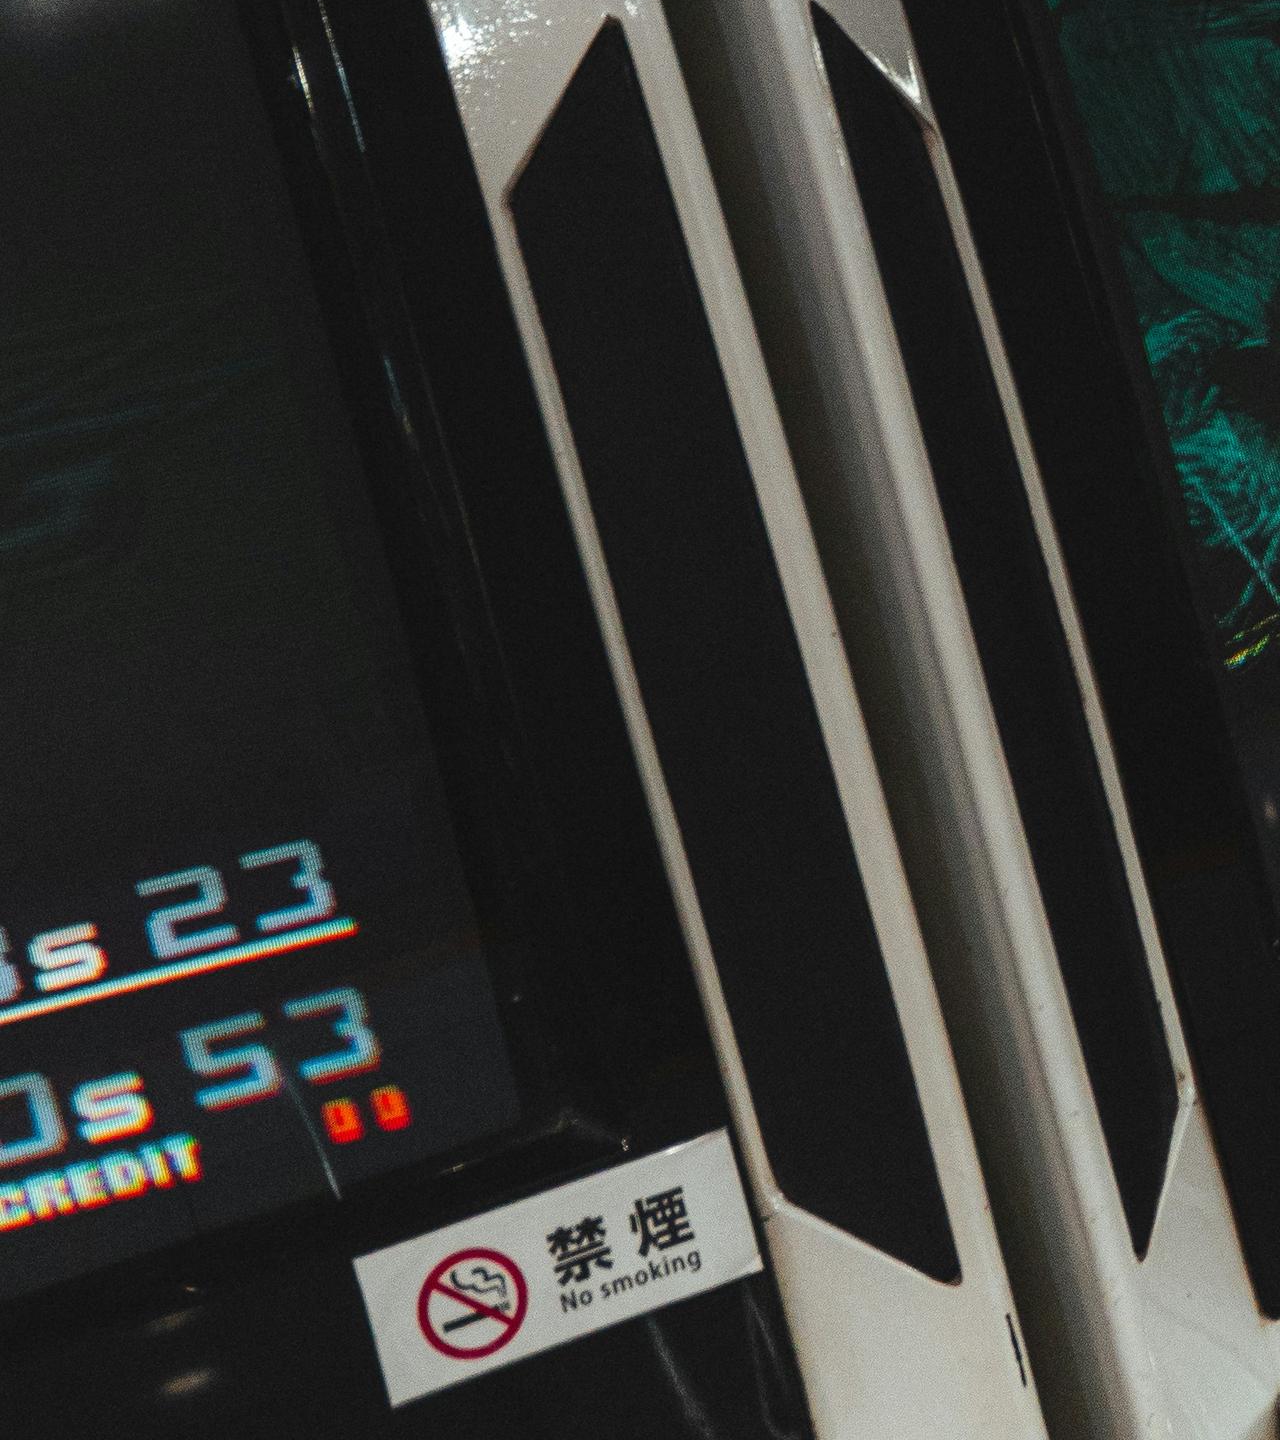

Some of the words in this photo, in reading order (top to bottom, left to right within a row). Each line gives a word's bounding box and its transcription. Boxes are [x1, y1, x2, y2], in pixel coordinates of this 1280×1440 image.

[134, 838, 338, 960] 23
[179, 985, 384, 1113] 53
[0, 1131, 203, 1234] CREDIT
[546, 1185, 696, 1288] 禁煙
[559, 1287, 595, 1315] No
[600, 1248, 702, 1301] smoking
